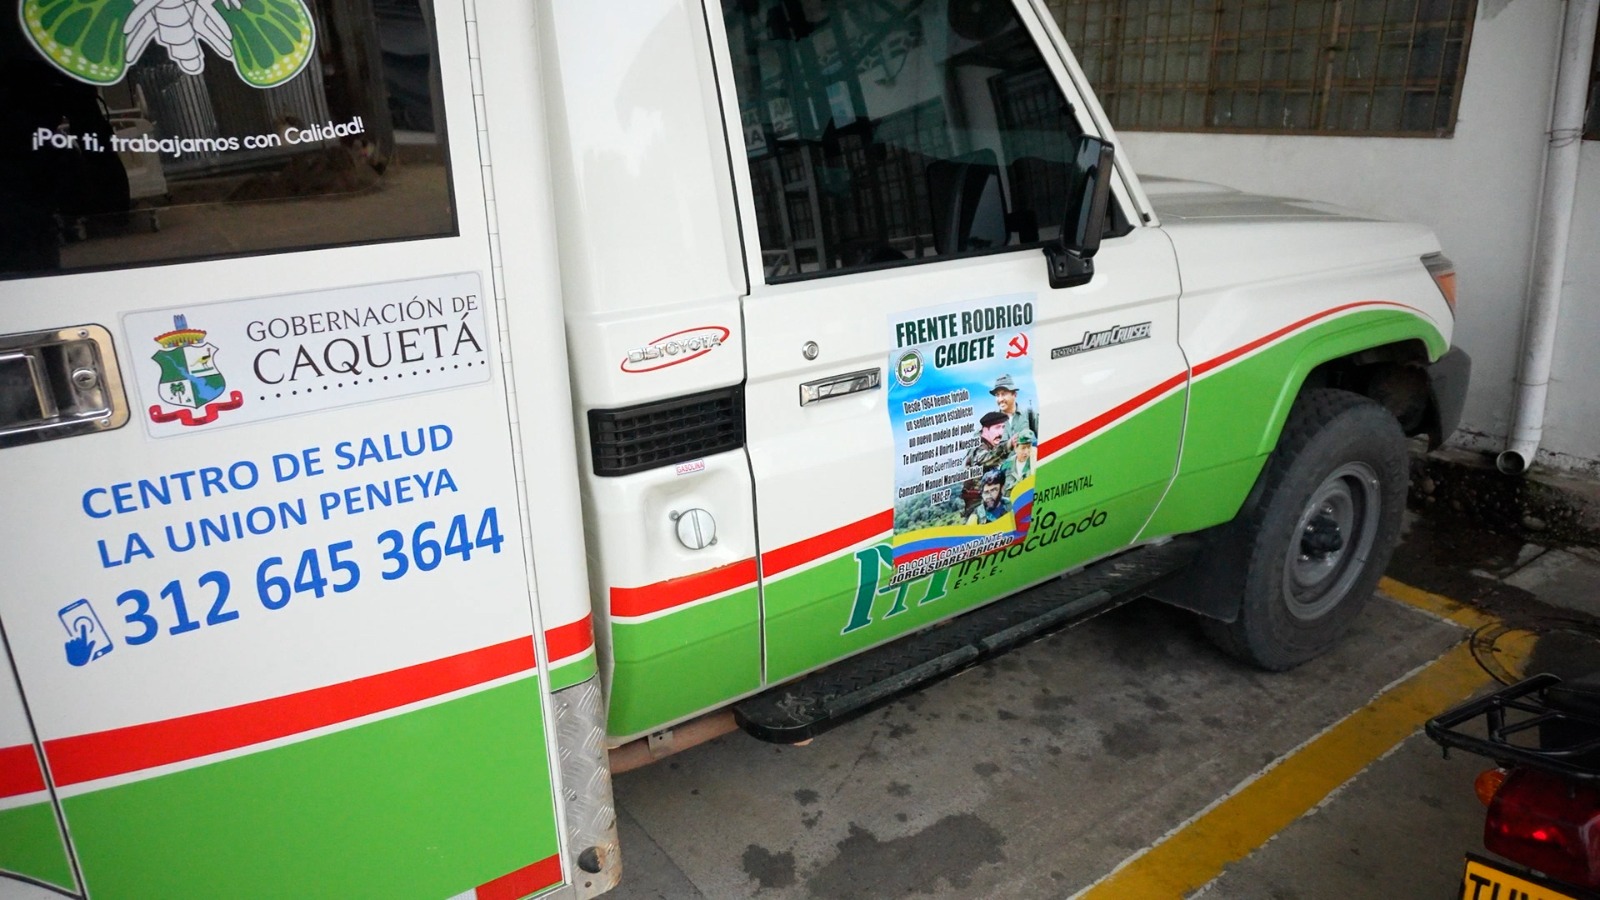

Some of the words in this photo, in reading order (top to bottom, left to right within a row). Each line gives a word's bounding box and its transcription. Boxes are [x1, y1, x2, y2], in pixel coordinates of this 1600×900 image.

[32, 127, 78, 151] ¡Por
[82, 132, 105, 153] ti,
[110, 133, 240, 158] trabajamos
[244, 133, 281, 149] con
[284, 116, 365, 145] Calidad!
[246, 296, 443, 343] GOBERNACIÓN
[452, 294, 478, 313] DE
[895, 313, 958, 348] FRENTE
[961, 302, 1033, 335] RODRIGO
[253, 311, 484, 386] CAQUETÁ
[934, 335, 995, 369] CADETE
[904, 400, 920, 414] Desde
[920, 397, 933, 410] 1964
[933, 394, 951, 408] hemos
[951, 390, 969, 405] forjado
[906, 421, 913, 431] un
[913, 416, 935, 430] sendero
[935, 413, 947, 426] para
[947, 407, 973, 422] establecer
[903, 455, 909, 466] Te
[910, 449, 934, 464] Invitamos
[935, 446, 939, 455] A
[939, 443, 954, 456] Unirte
[954, 442, 959, 452] A
[959, 438, 980, 451] Nuestras
[909, 438, 916, 448] un
[916, 434, 932, 446] nuevo
[932, 428, 951, 442] modelo
[951, 425, 959, 437] del
[81, 460, 260, 519] CENTRO
[272, 447, 324, 483] DE
[335, 424, 454, 470] SALUD
[677, 461, 703, 474] GASOLINA
[899, 484, 924, 498] Camarada
[925, 477, 943, 491] Manuel
[944, 469, 970, 486] Marulanda
[922, 464, 934, 477] Filas
[934, 457, 963, 473] Guerrilleras
[931, 490, 951, 504] FARC-EP
[1032, 474, 1094, 506] PARTAMENTAL
[97, 531, 155, 569] LA
[165, 498, 308, 554] UNION
[322, 467, 458, 520] PENEYA
[891, 568, 926, 585] JORGE
[928, 552, 967, 572] SUAREZ
[898, 553, 937, 574] BLOQUE
[940, 532, 1003, 558] COMANDANTE
[116, 570, 241, 646] 312
[256, 540, 362, 611] 645
[376, 506, 504, 581] 3644
